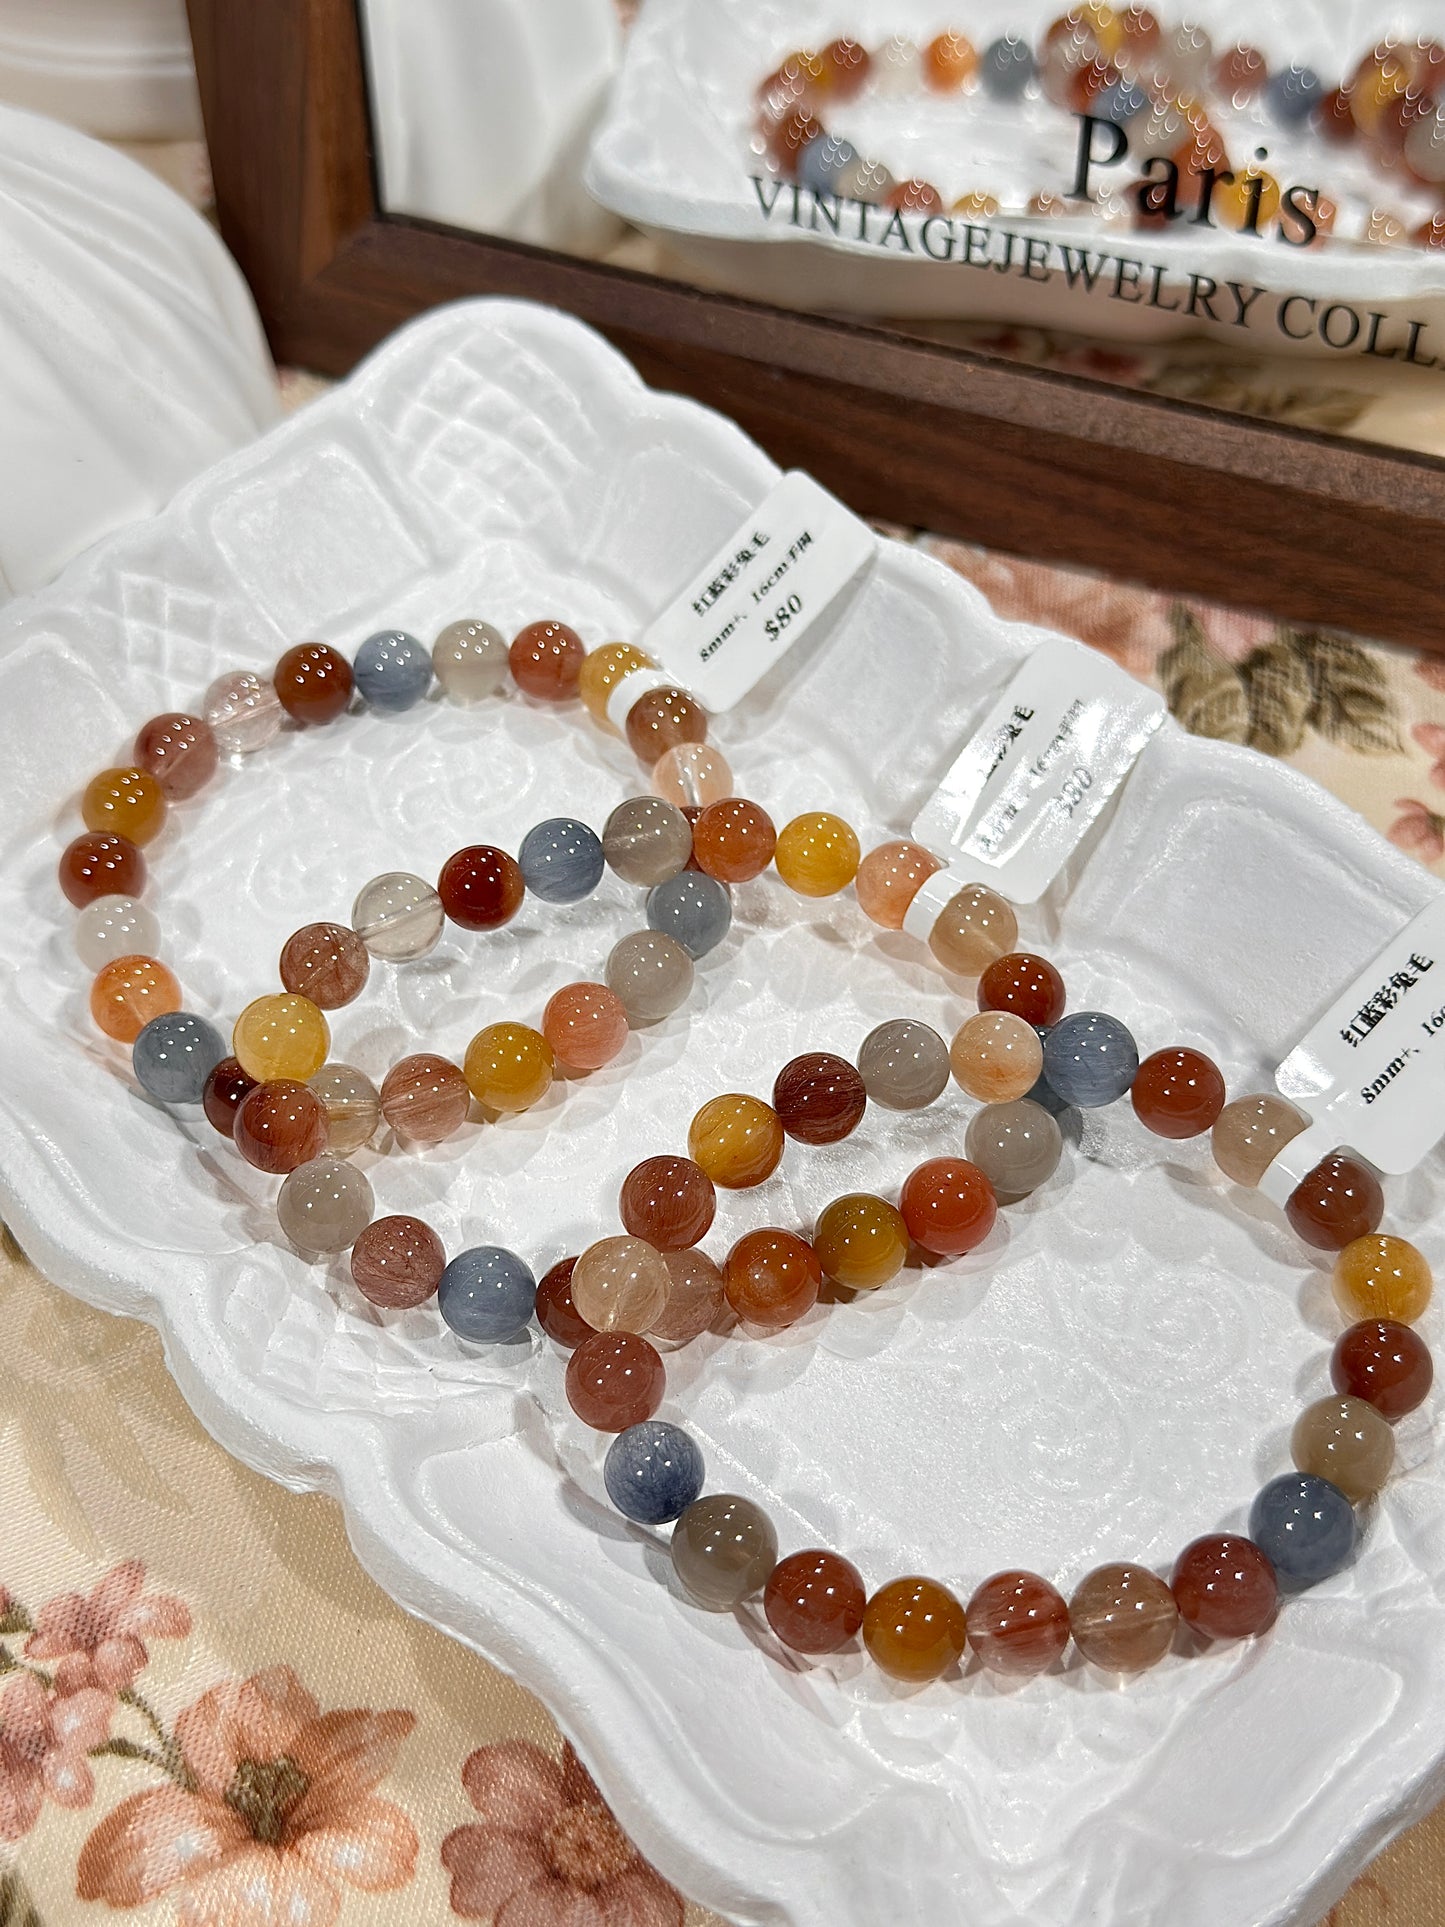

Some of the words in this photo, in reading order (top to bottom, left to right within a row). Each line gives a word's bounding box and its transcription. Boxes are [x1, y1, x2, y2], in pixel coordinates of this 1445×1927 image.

[1062, 113, 1319, 248] Paris
[1276, 296, 1445, 374] COLL
[764, 594, 803, 642] $80
[1337, 950, 1435, 1048] 红蓝彩兔毛
